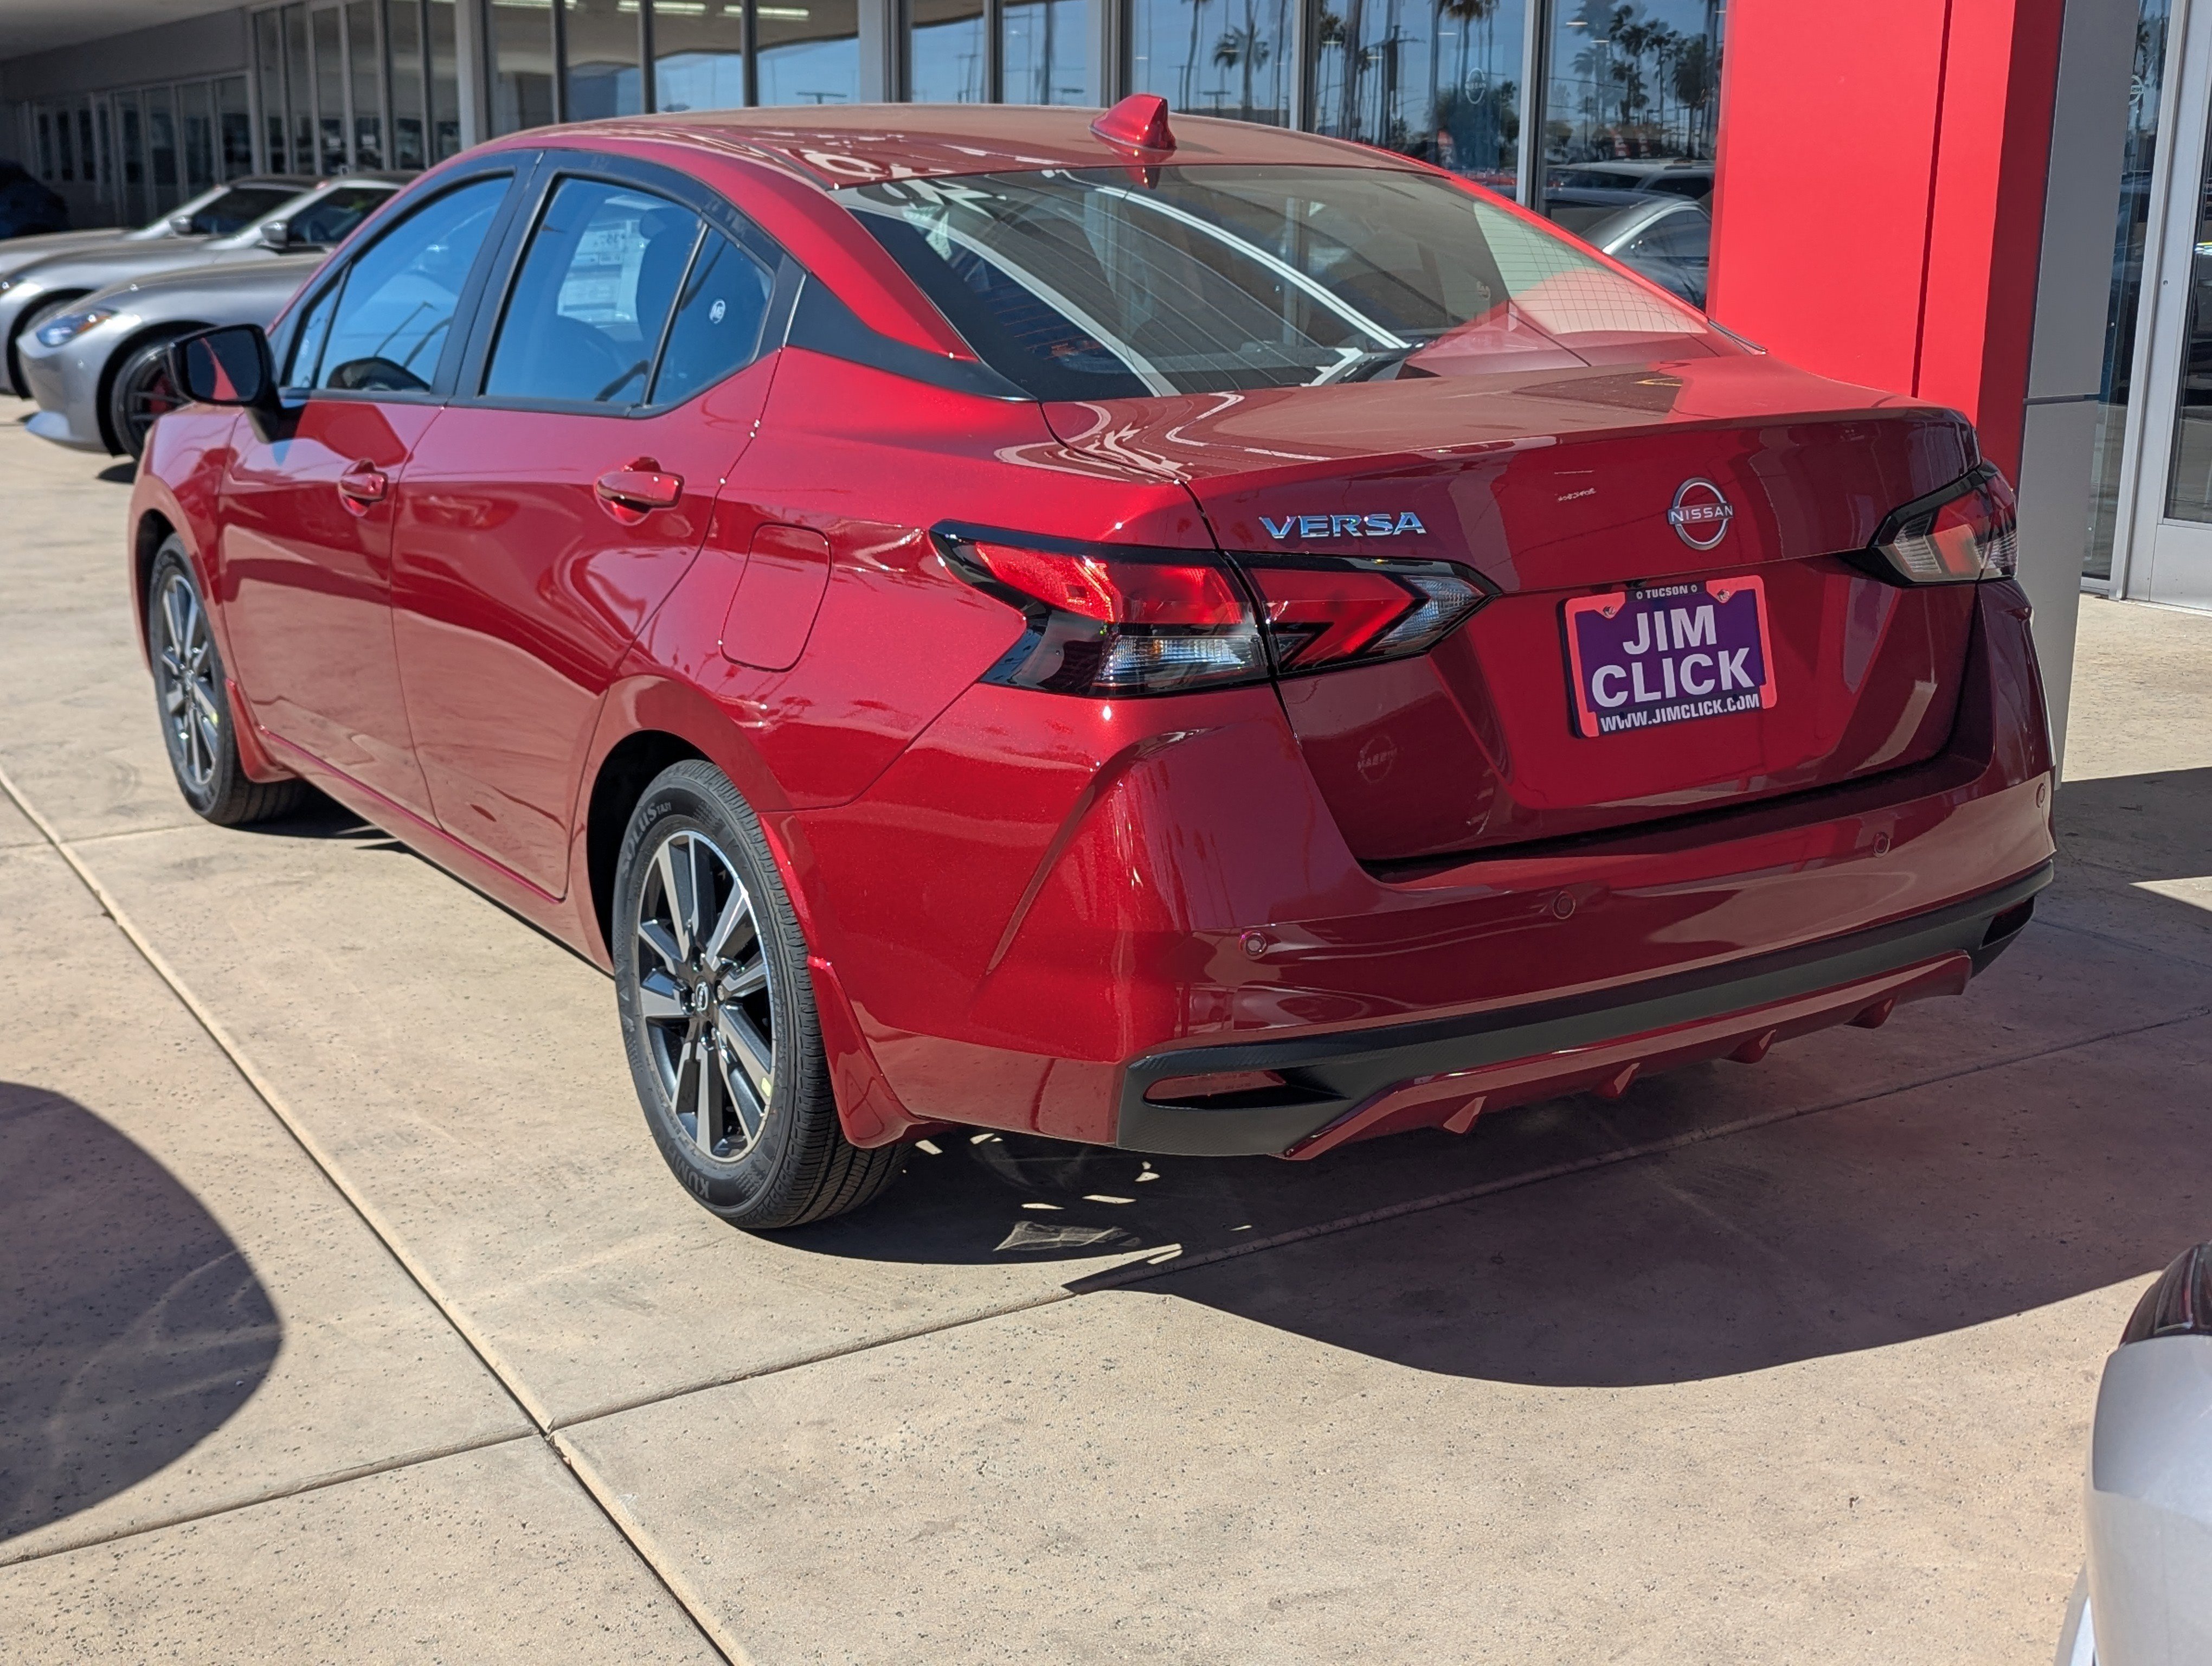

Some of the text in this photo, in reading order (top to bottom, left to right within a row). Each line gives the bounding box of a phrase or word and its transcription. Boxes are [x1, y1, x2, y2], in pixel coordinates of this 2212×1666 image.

[1258, 512, 1427, 539] VERSA
[1670, 505, 1733, 522] NISSAN
[1645, 585, 1688, 599] TUCSON
[1623, 605, 1717, 655] JIM
[1592, 647, 1755, 707] CLICK
[1600, 693, 1760, 732] WWW.JIMCLICK.COM
